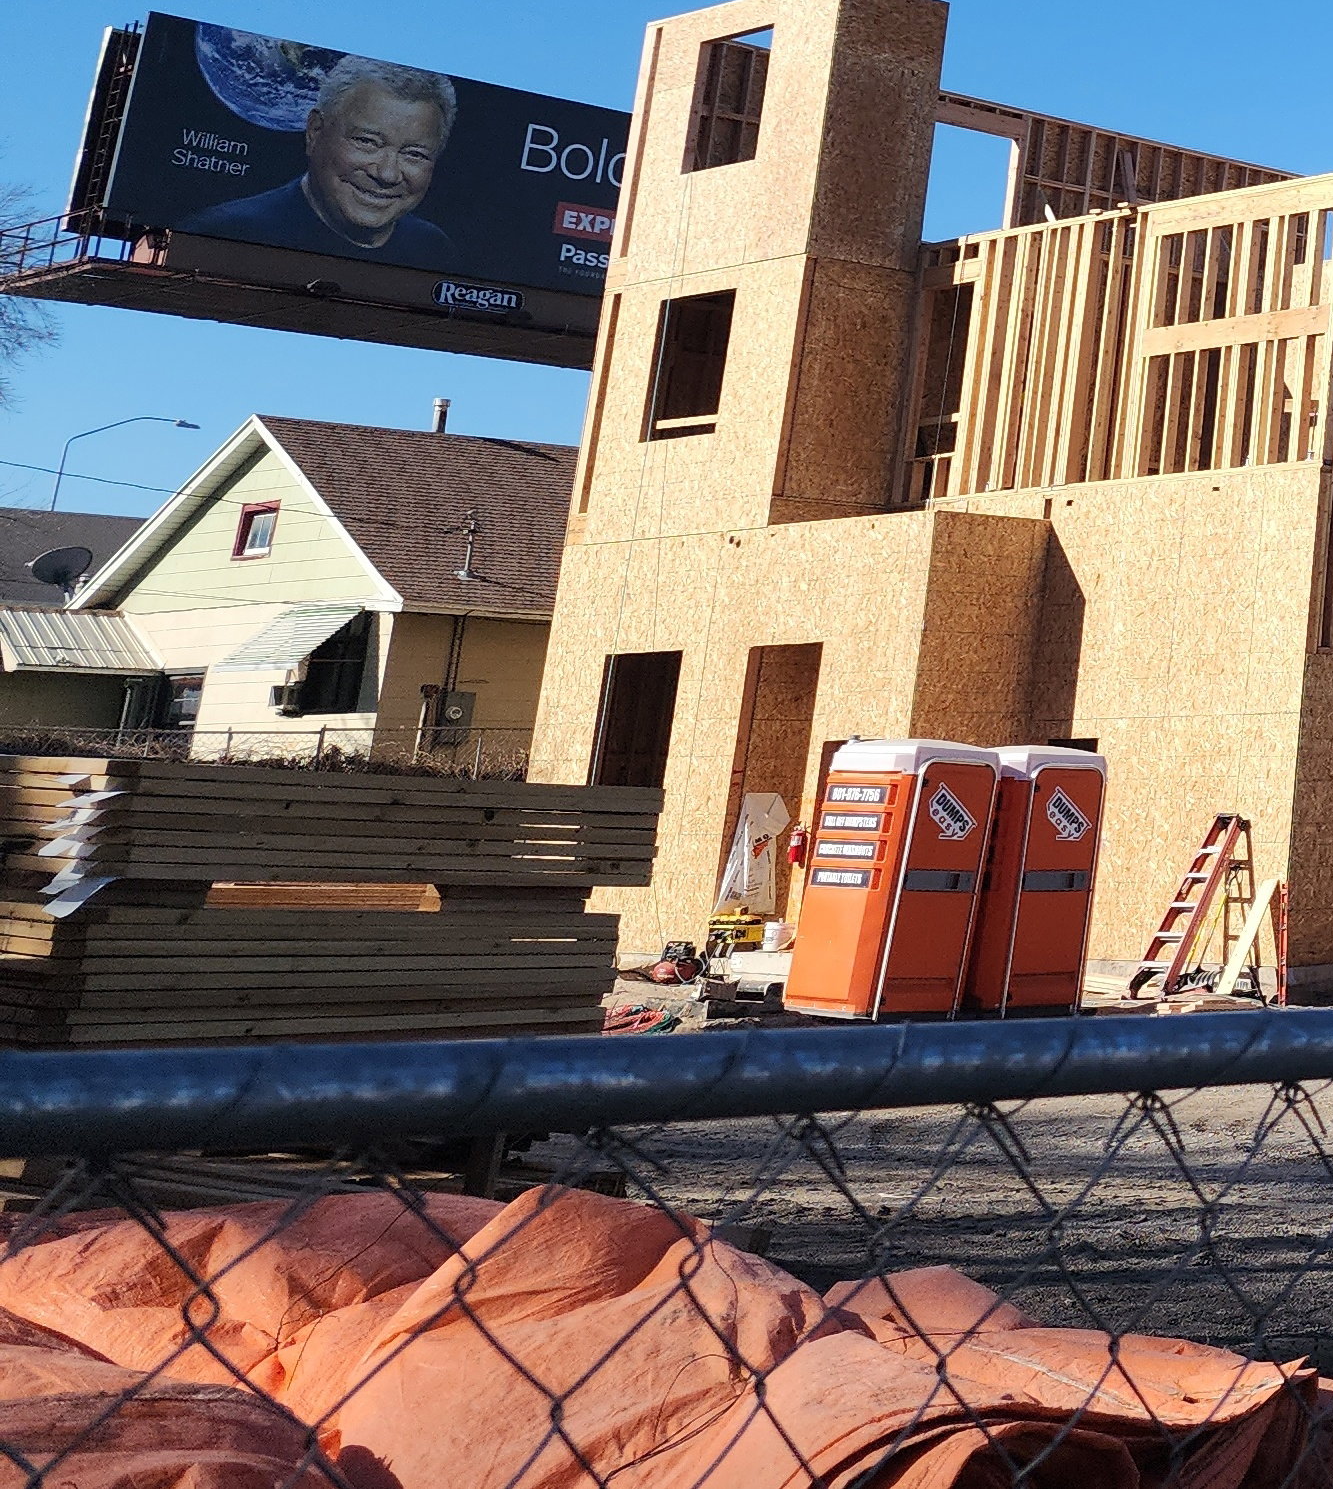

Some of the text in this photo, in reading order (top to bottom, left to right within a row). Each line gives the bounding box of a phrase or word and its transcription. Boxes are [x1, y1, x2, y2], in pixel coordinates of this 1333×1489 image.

[183, 128, 248, 156] William
[171, 148, 251, 176] Shatner
[559, 243, 610, 269] Pass
[439, 282, 518, 309] Reagan
[932, 808, 958, 838] easy
[935, 792, 970, 833] DUMPS
[1049, 811, 1075, 839] easy
[1052, 796, 1085, 834] DUMPS
